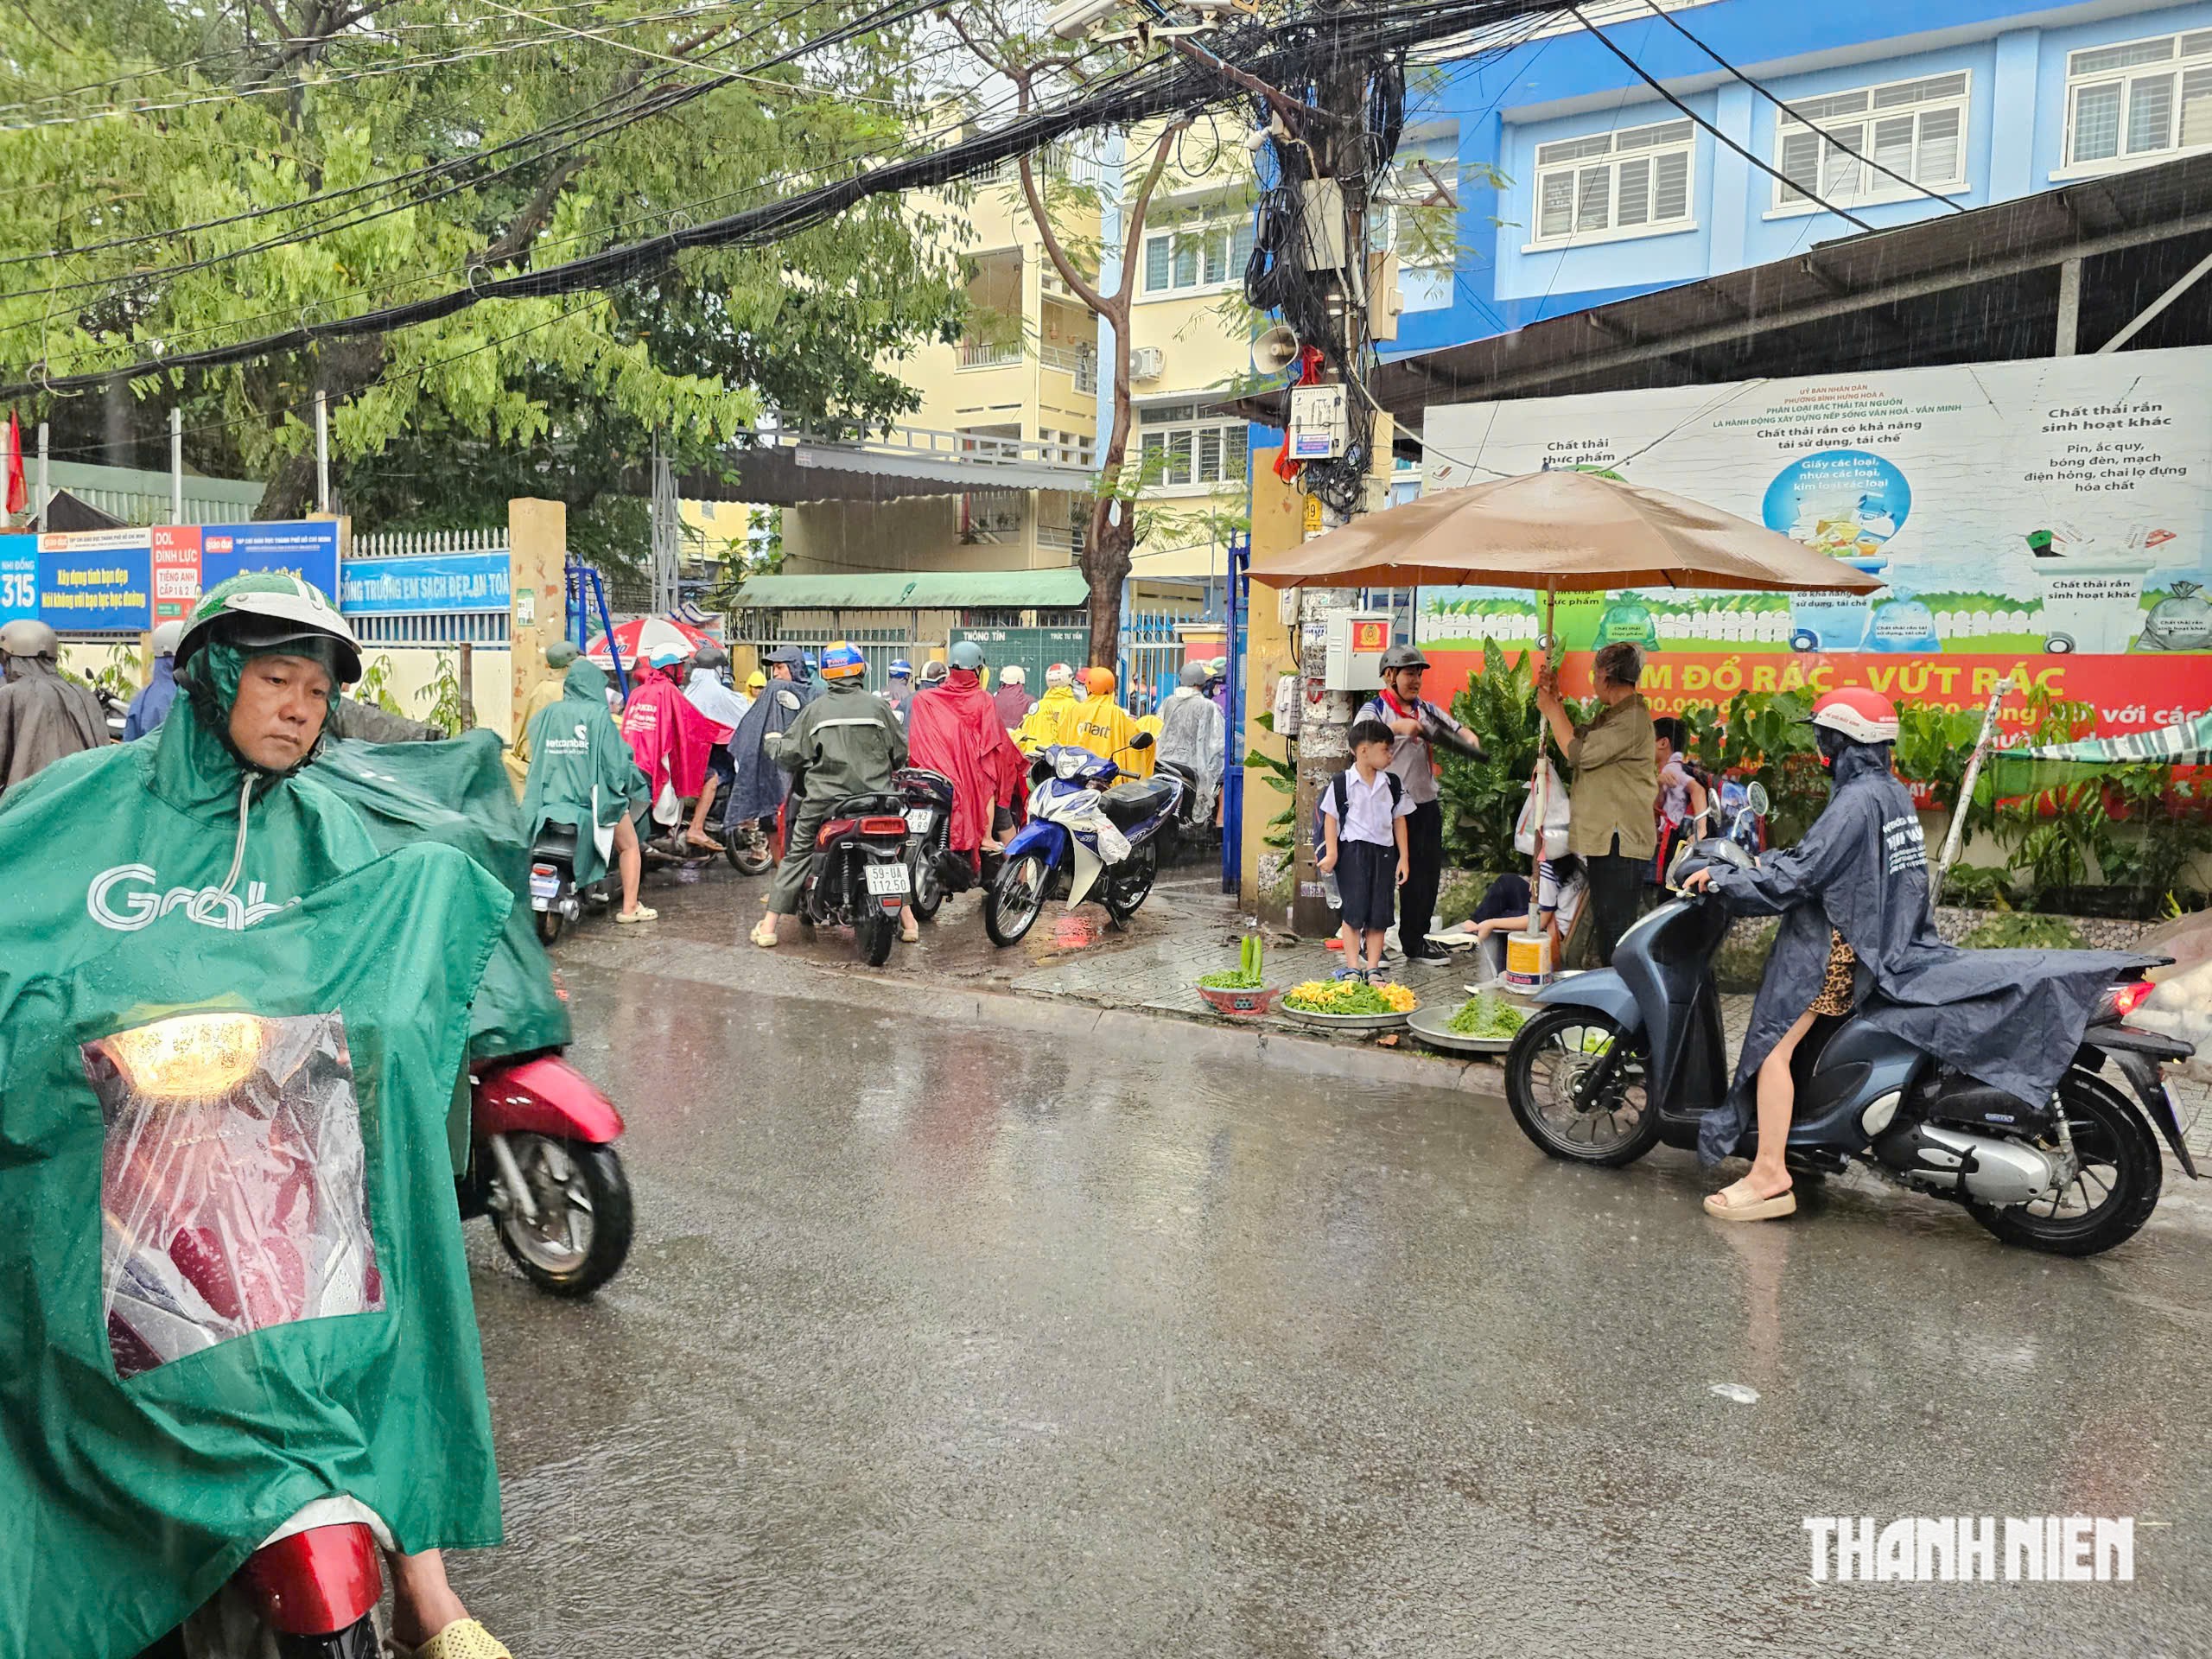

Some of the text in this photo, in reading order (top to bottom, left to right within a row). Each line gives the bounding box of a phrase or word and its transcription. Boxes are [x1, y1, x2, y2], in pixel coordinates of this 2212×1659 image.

[2049, 405, 2088, 418] Chất
[2133, 401, 2163, 414] rắn
[1757, 420, 1923, 439] Chất thải rắn có khả năng
[2042, 416, 2172, 433] sinh hoạt khác
[1548, 438, 1609, 451] Chất thải
[1778, 432, 1901, 449] tái sử dụng, tái chế
[2067, 444, 2092, 454] Pin,
[2114, 442, 2145, 454] quy,
[1576, 451, 1615, 465] phẩm
[1831, 458, 1851, 467] các
[2050, 453, 2161, 468] bóng đèn, mạch
[1833, 470, 1852, 479] các
[2024, 472, 2054, 483] điện
[2100, 467, 2129, 478] chai
[2133, 467, 2145, 478] lọ
[2150, 466, 2187, 476] đựng
[1794, 482, 1815, 492] kim
[2075, 480, 2135, 492] hóa chất
[156, 532, 175, 545] DOL
[156, 549, 198, 567] ĐÌNH LỰC
[2, 561, 15, 570] NHI
[159, 569, 180, 582] TIẾNG
[1, 574, 35, 607] 315
[159, 584, 173, 596] CẤP
[404, 575, 420, 600] EM
[422, 575, 445, 602] SẠCH
[2053, 580, 2080, 588] Chất
[2083, 580, 2107, 588] thải
[2048, 590, 2137, 601] sinh hoạt khác
[1681, 655, 1742, 692] ĐỔ
[1752, 658, 1834, 693] RÁC
[1866, 660, 1961, 693] VỨT
[1972, 661, 2066, 696] RÁC
[2102, 704, 2146, 724] với
[2153, 705, 2201, 725] các
[872, 867, 903, 880] 59-UA
[872, 880, 906, 893] 112.50
